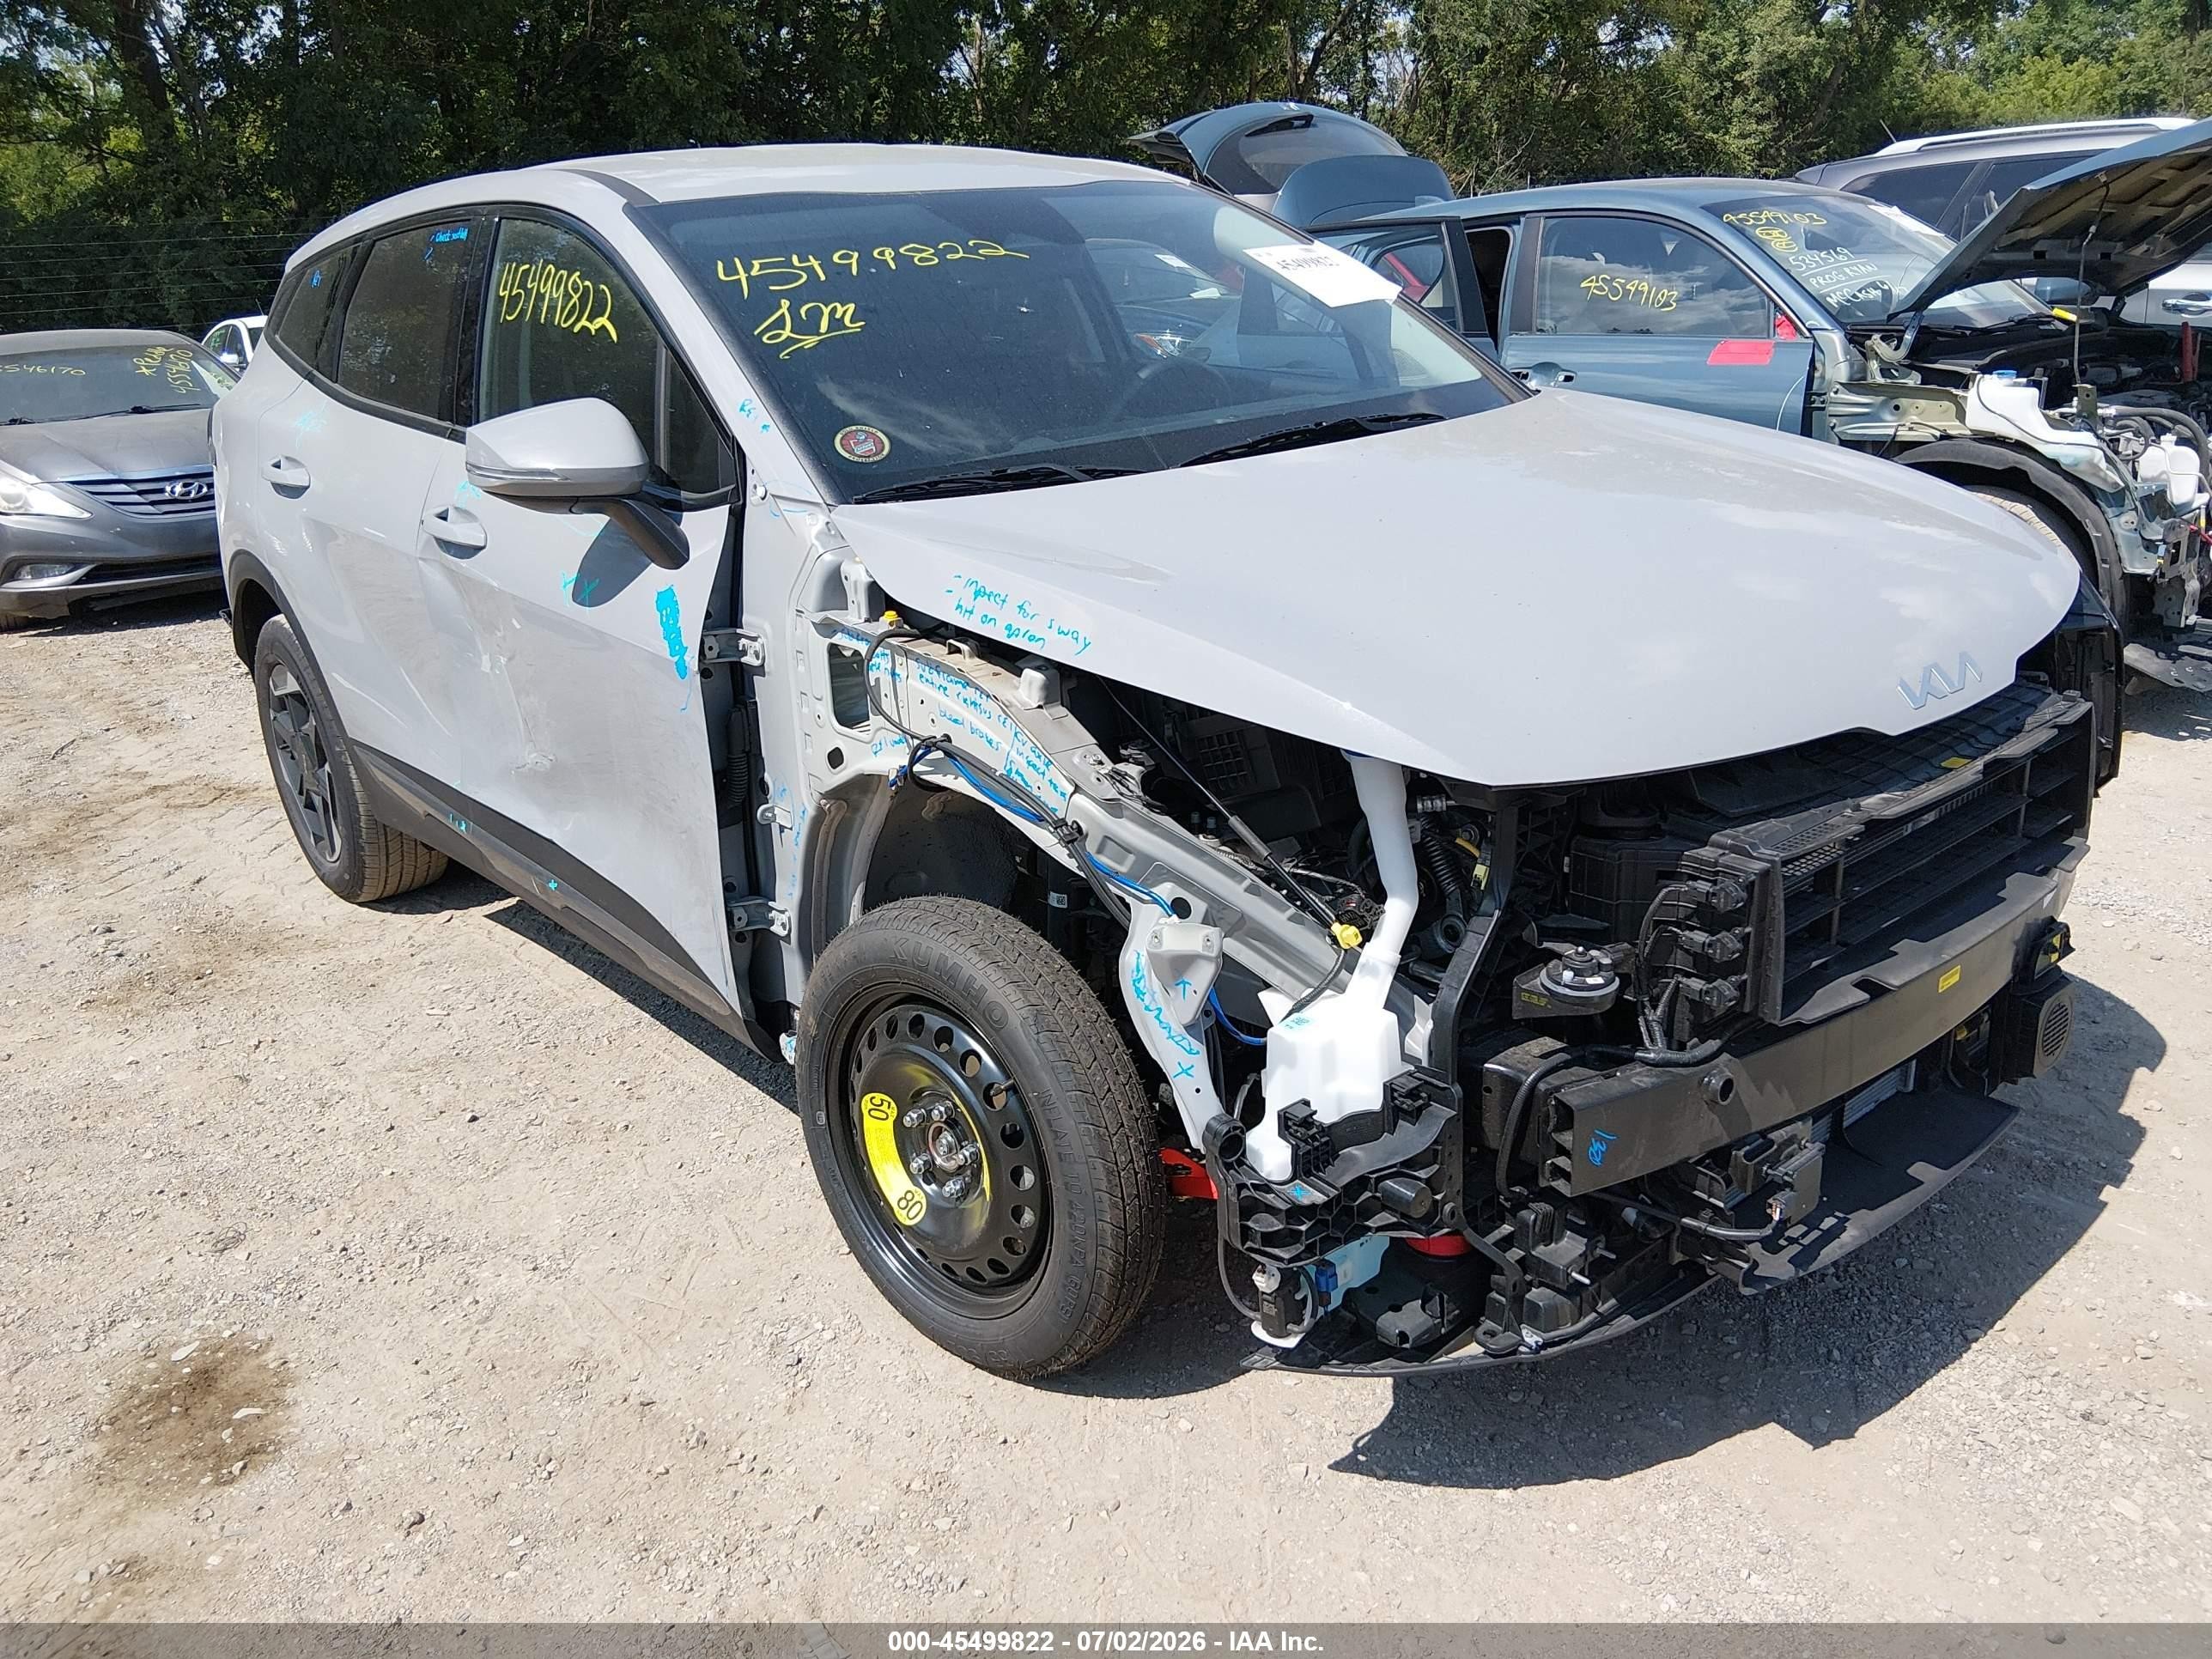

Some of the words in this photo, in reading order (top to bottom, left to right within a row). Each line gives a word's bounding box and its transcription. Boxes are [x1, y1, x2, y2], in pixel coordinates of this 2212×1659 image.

[717, 240, 1030, 300] 45499822
[1580, 275, 1678, 311] 45549103
[499, 258, 617, 343] 45499822
[0, 363, 86, 376] 546170
[981, 614, 997, 628] on
[1017, 600, 1040, 621] for
[1047, 618, 1091, 656] sway
[1896, 652, 1983, 711] KIA
[889, 937, 1009, 1029] KUMHO
[867, 1096, 891, 1121] 50
[896, 1190, 923, 1220] 80
